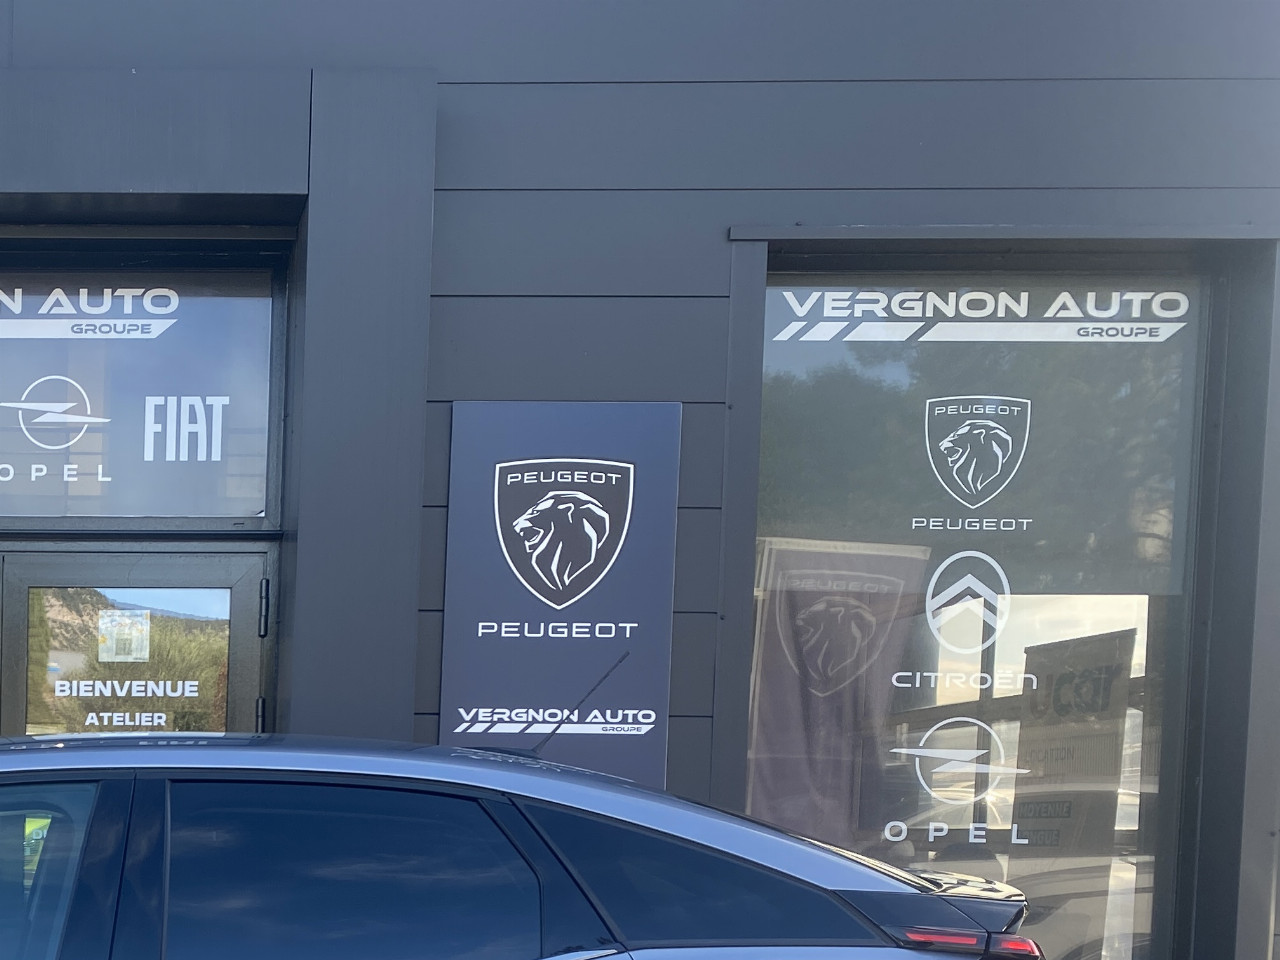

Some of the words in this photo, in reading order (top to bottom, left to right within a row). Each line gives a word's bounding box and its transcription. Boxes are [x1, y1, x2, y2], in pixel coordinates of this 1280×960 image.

[37, 287, 180, 315] AUTO
[781, 290, 1028, 318] VERGNON
[1042, 290, 1190, 318] AUTO
[70, 323, 153, 335] GROUPE
[1076, 325, 1161, 339] GROUPE
[933, 404, 1022, 416] PEUGEOT
[143, 395, 230, 462] FIAT
[506, 470, 622, 486] PEUGEOT
[911, 517, 1033, 531] PEUGEOT
[477, 622, 639, 638] PEUGEOT
[54, 680, 199, 697] BIENVENUE
[84, 712, 167, 726] ATELIER
[457, 707, 579, 723] VERGNON
[584, 709, 657, 724] AUTO
[601, 725, 643, 733] GROUPE
[883, 820, 1030, 846] OPEL
